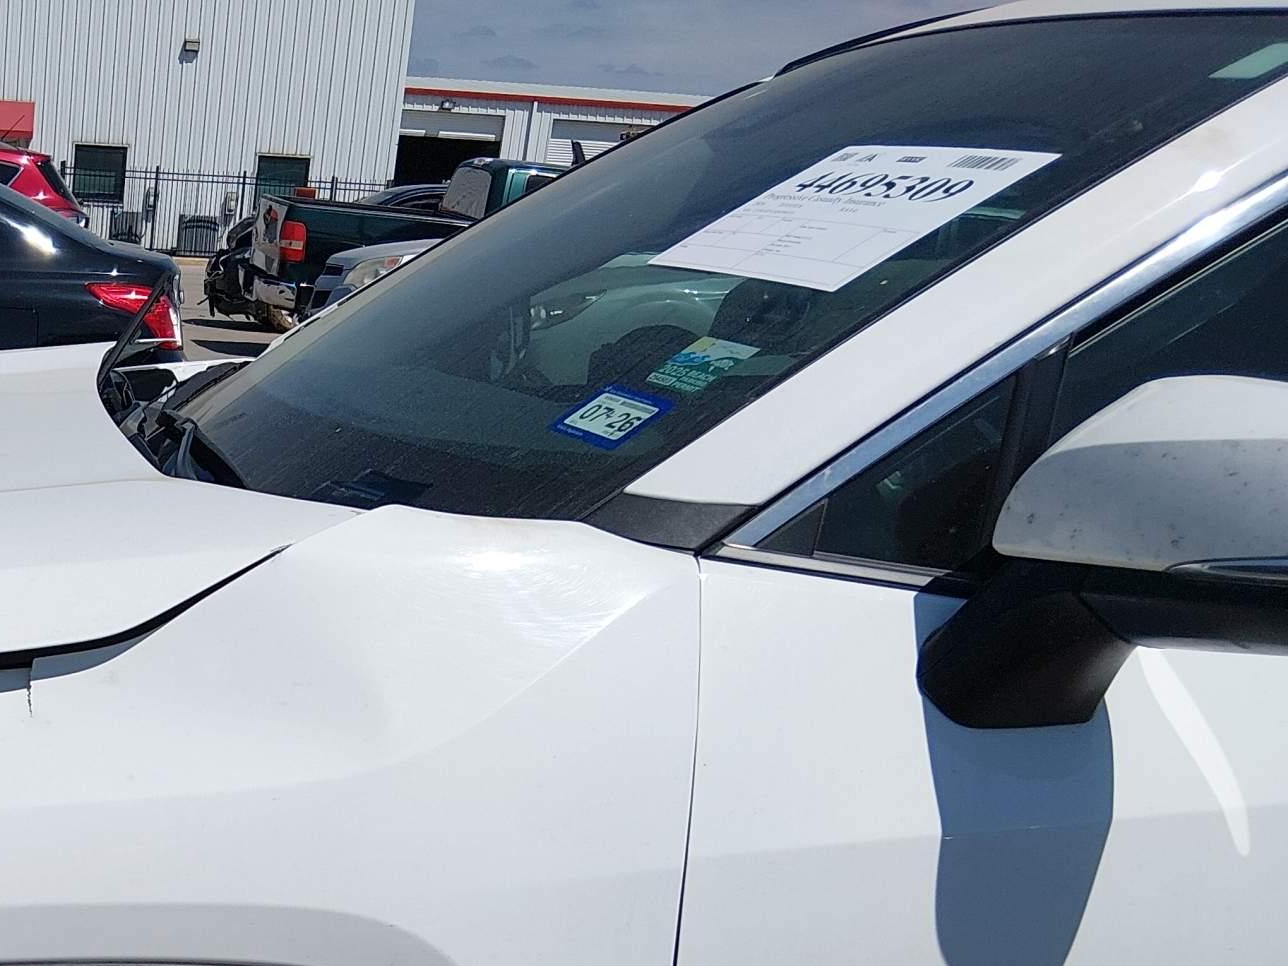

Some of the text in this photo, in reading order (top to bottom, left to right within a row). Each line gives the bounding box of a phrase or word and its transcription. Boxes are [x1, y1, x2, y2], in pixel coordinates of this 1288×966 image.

[795, 171, 974, 202] 44695309
[579, 404, 614, 422] 07
[605, 412, 643, 432] 26
